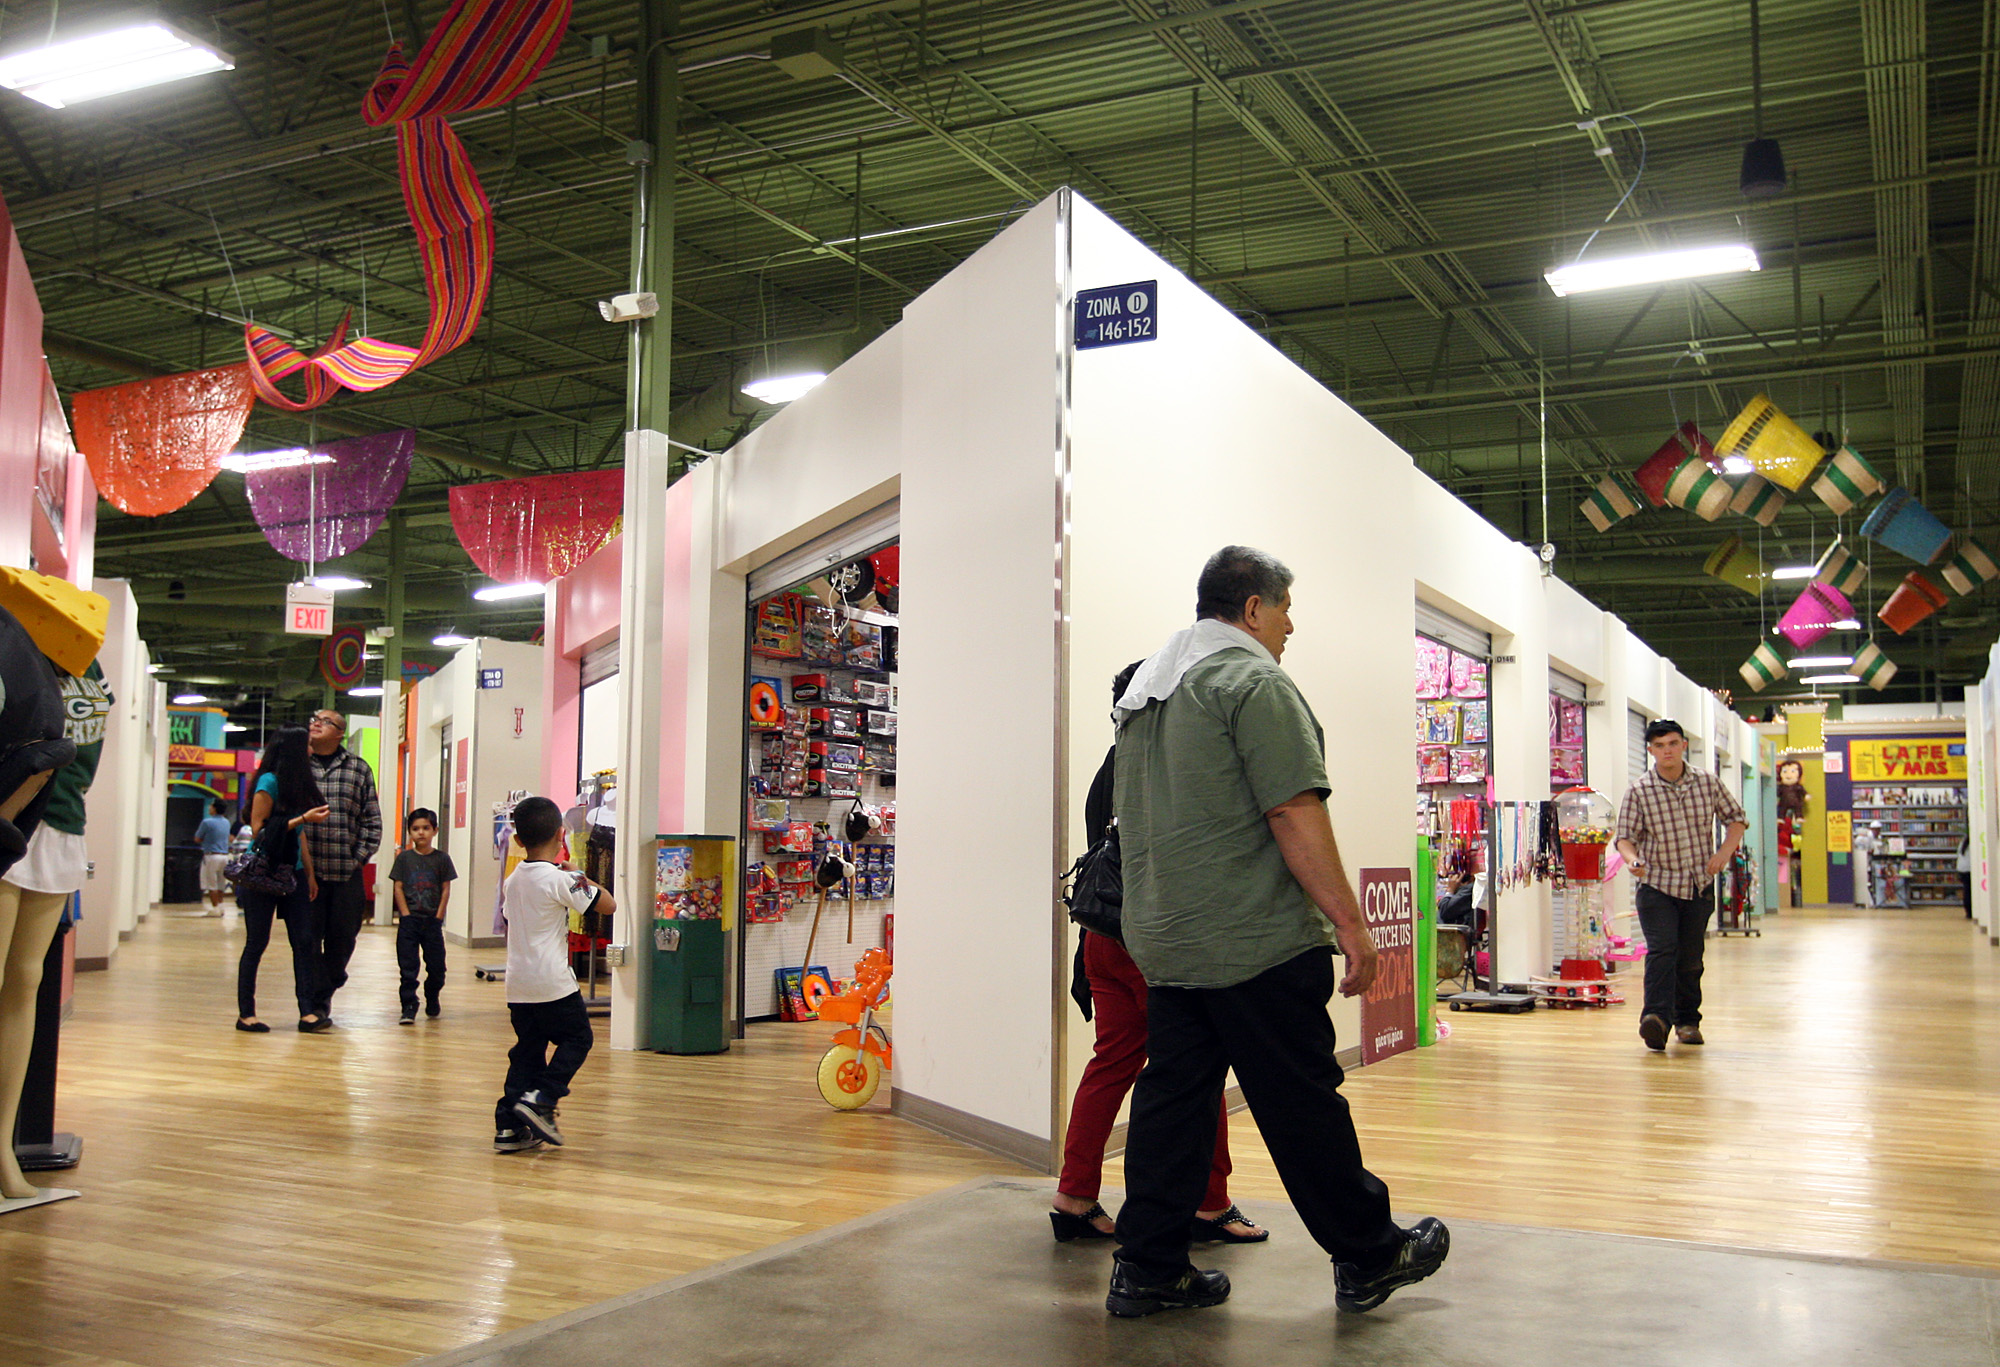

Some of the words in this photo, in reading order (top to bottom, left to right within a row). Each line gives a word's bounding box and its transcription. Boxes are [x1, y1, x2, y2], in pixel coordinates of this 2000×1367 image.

[1086, 296, 1121, 319] ZONA
[1099, 316, 1151, 341] 146-152
[294, 608, 327, 630] EXIT
[1882, 746, 1909, 760] LA
[1916, 745, 1944, 760] FE
[1883, 761, 1897, 776] Y
[1903, 761, 1948, 776] MAS
[1365, 881, 1410, 923] COME
[1400, 923, 1411, 946] US
